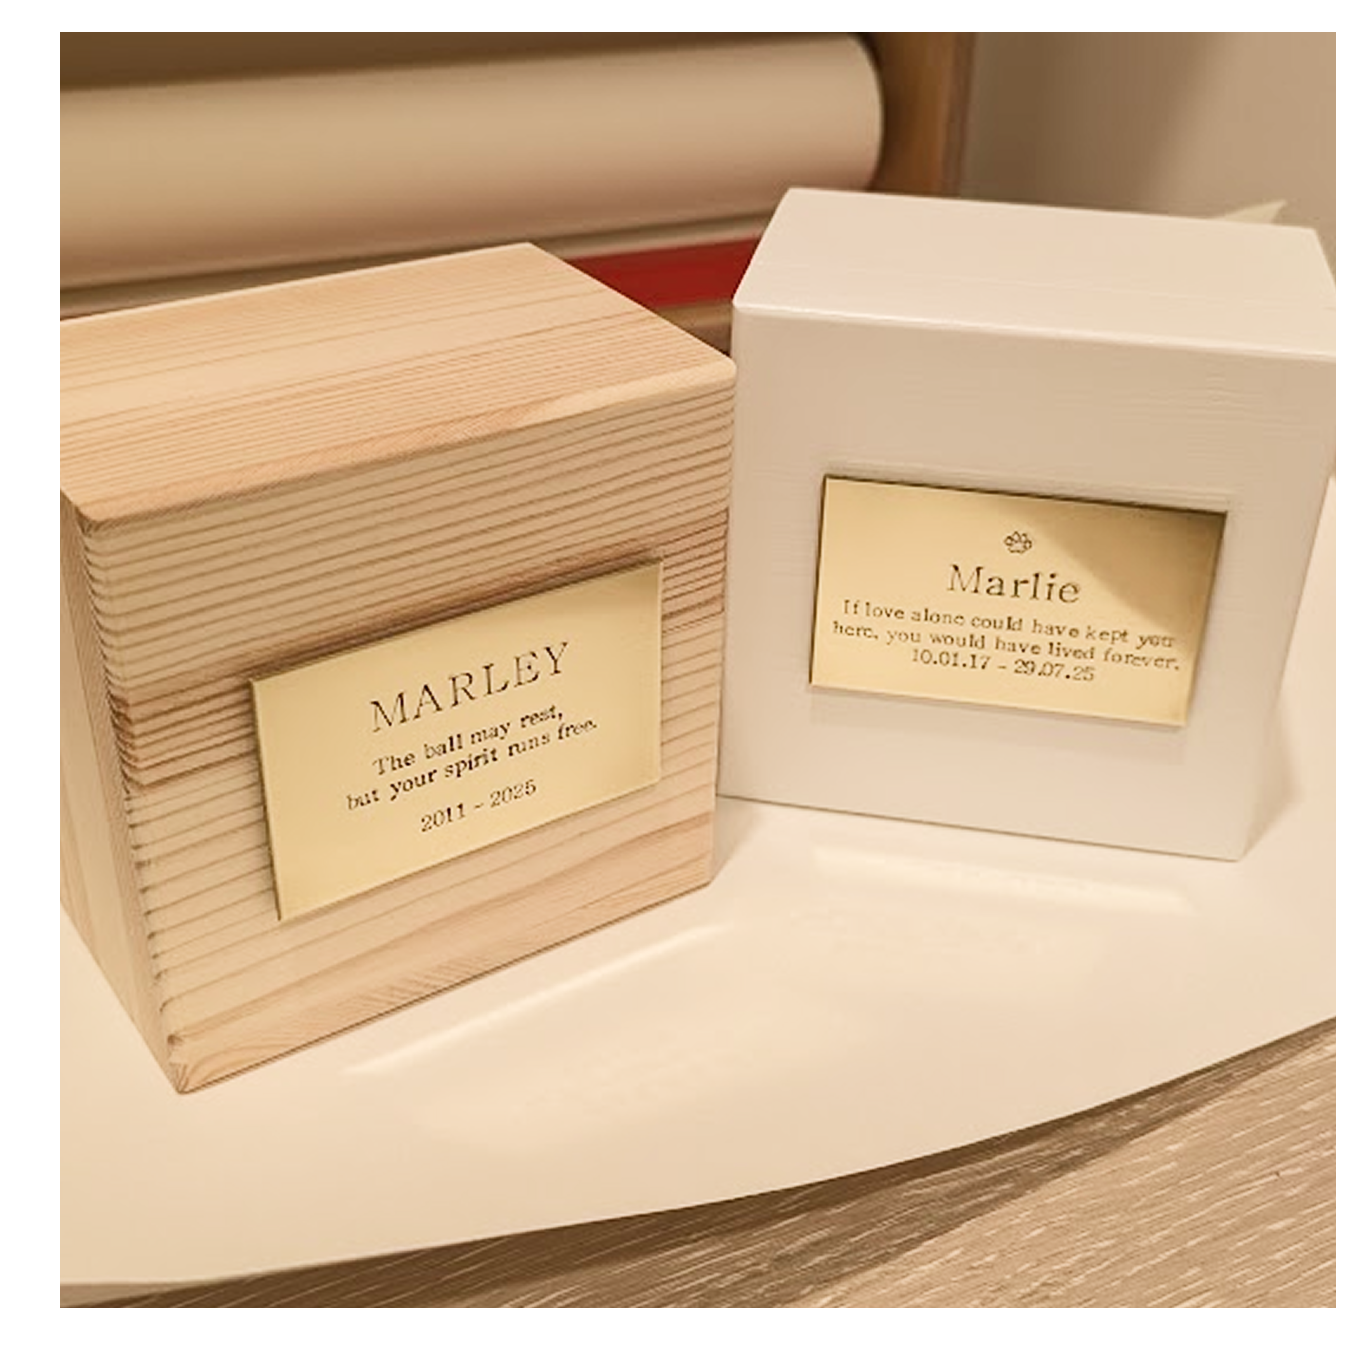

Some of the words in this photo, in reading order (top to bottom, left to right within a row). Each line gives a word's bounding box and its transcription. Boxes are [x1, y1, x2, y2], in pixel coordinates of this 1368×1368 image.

[947, 563, 1081, 605] Marlie
[843, 598, 861, 616] If
[865, 600, 905, 620] love
[911, 607, 966, 626] alone
[971, 615, 1023, 633] could
[1032, 618, 1080, 639] have
[1085, 624, 1129, 646] kept
[1136, 633, 1176, 651] you
[886, 629, 921, 646] you
[929, 633, 986, 651] would
[995, 636, 1042, 656] have
[1048, 641, 1096, 660] lived
[369, 641, 568, 733] MARLEY
[911, 648, 992, 671] 10.01.17
[1013, 658, 1096, 682] 29.07.25
[372, 750, 416, 776] The
[423, 732, 464, 760] ball
[469, 721, 511, 746] may
[520, 703, 563, 728] rest,
[345, 787, 381, 811] but
[389, 768, 438, 802] your
[443, 746, 500, 779] spirit
[507, 732, 551, 758] runs
[420, 802, 466, 833] 2011
[488, 778, 537, 808] 2025
